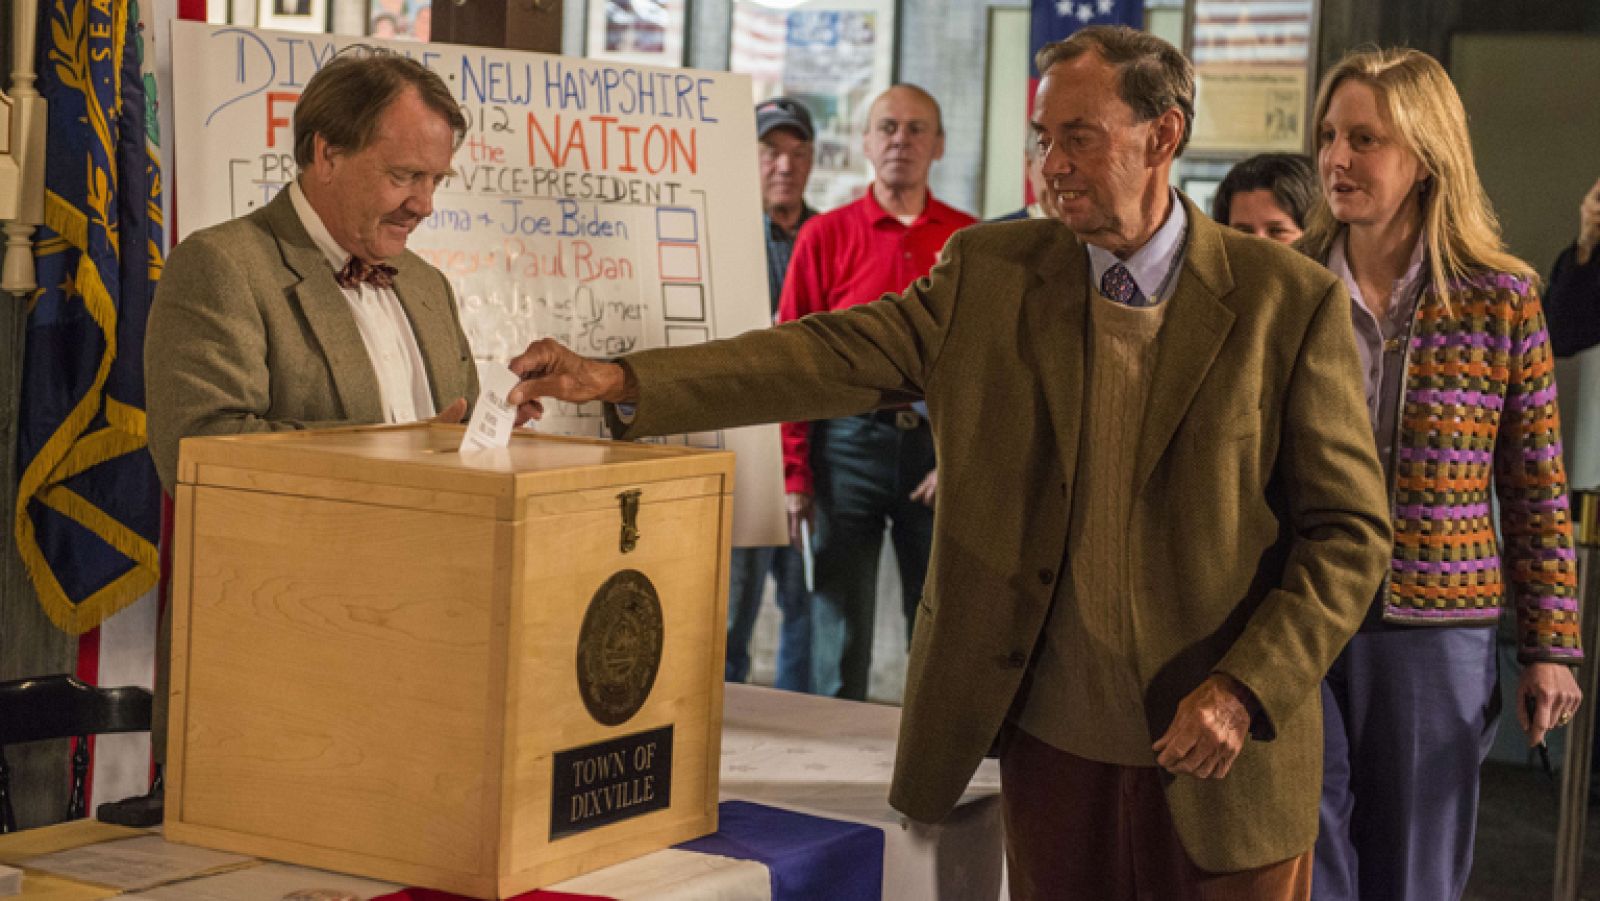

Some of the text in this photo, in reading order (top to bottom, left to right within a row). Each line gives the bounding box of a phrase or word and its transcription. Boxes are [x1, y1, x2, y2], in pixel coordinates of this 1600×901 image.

[461, 54, 532, 105] NEW
[544, 59, 719, 124] HAMPSHIRE
[464, 111, 698, 176] the NATION
[459, 164, 682, 205] VICE-PRESIDENT
[426, 208, 473, 232] ama
[501, 199, 551, 235] Joe
[556, 198, 630, 240] Biden
[503, 236, 568, 280] Paul
[571, 240, 633, 283] Ryan
[572, 741, 657, 788] TOWN OF
[570, 775, 655, 823] DIXVILLE
